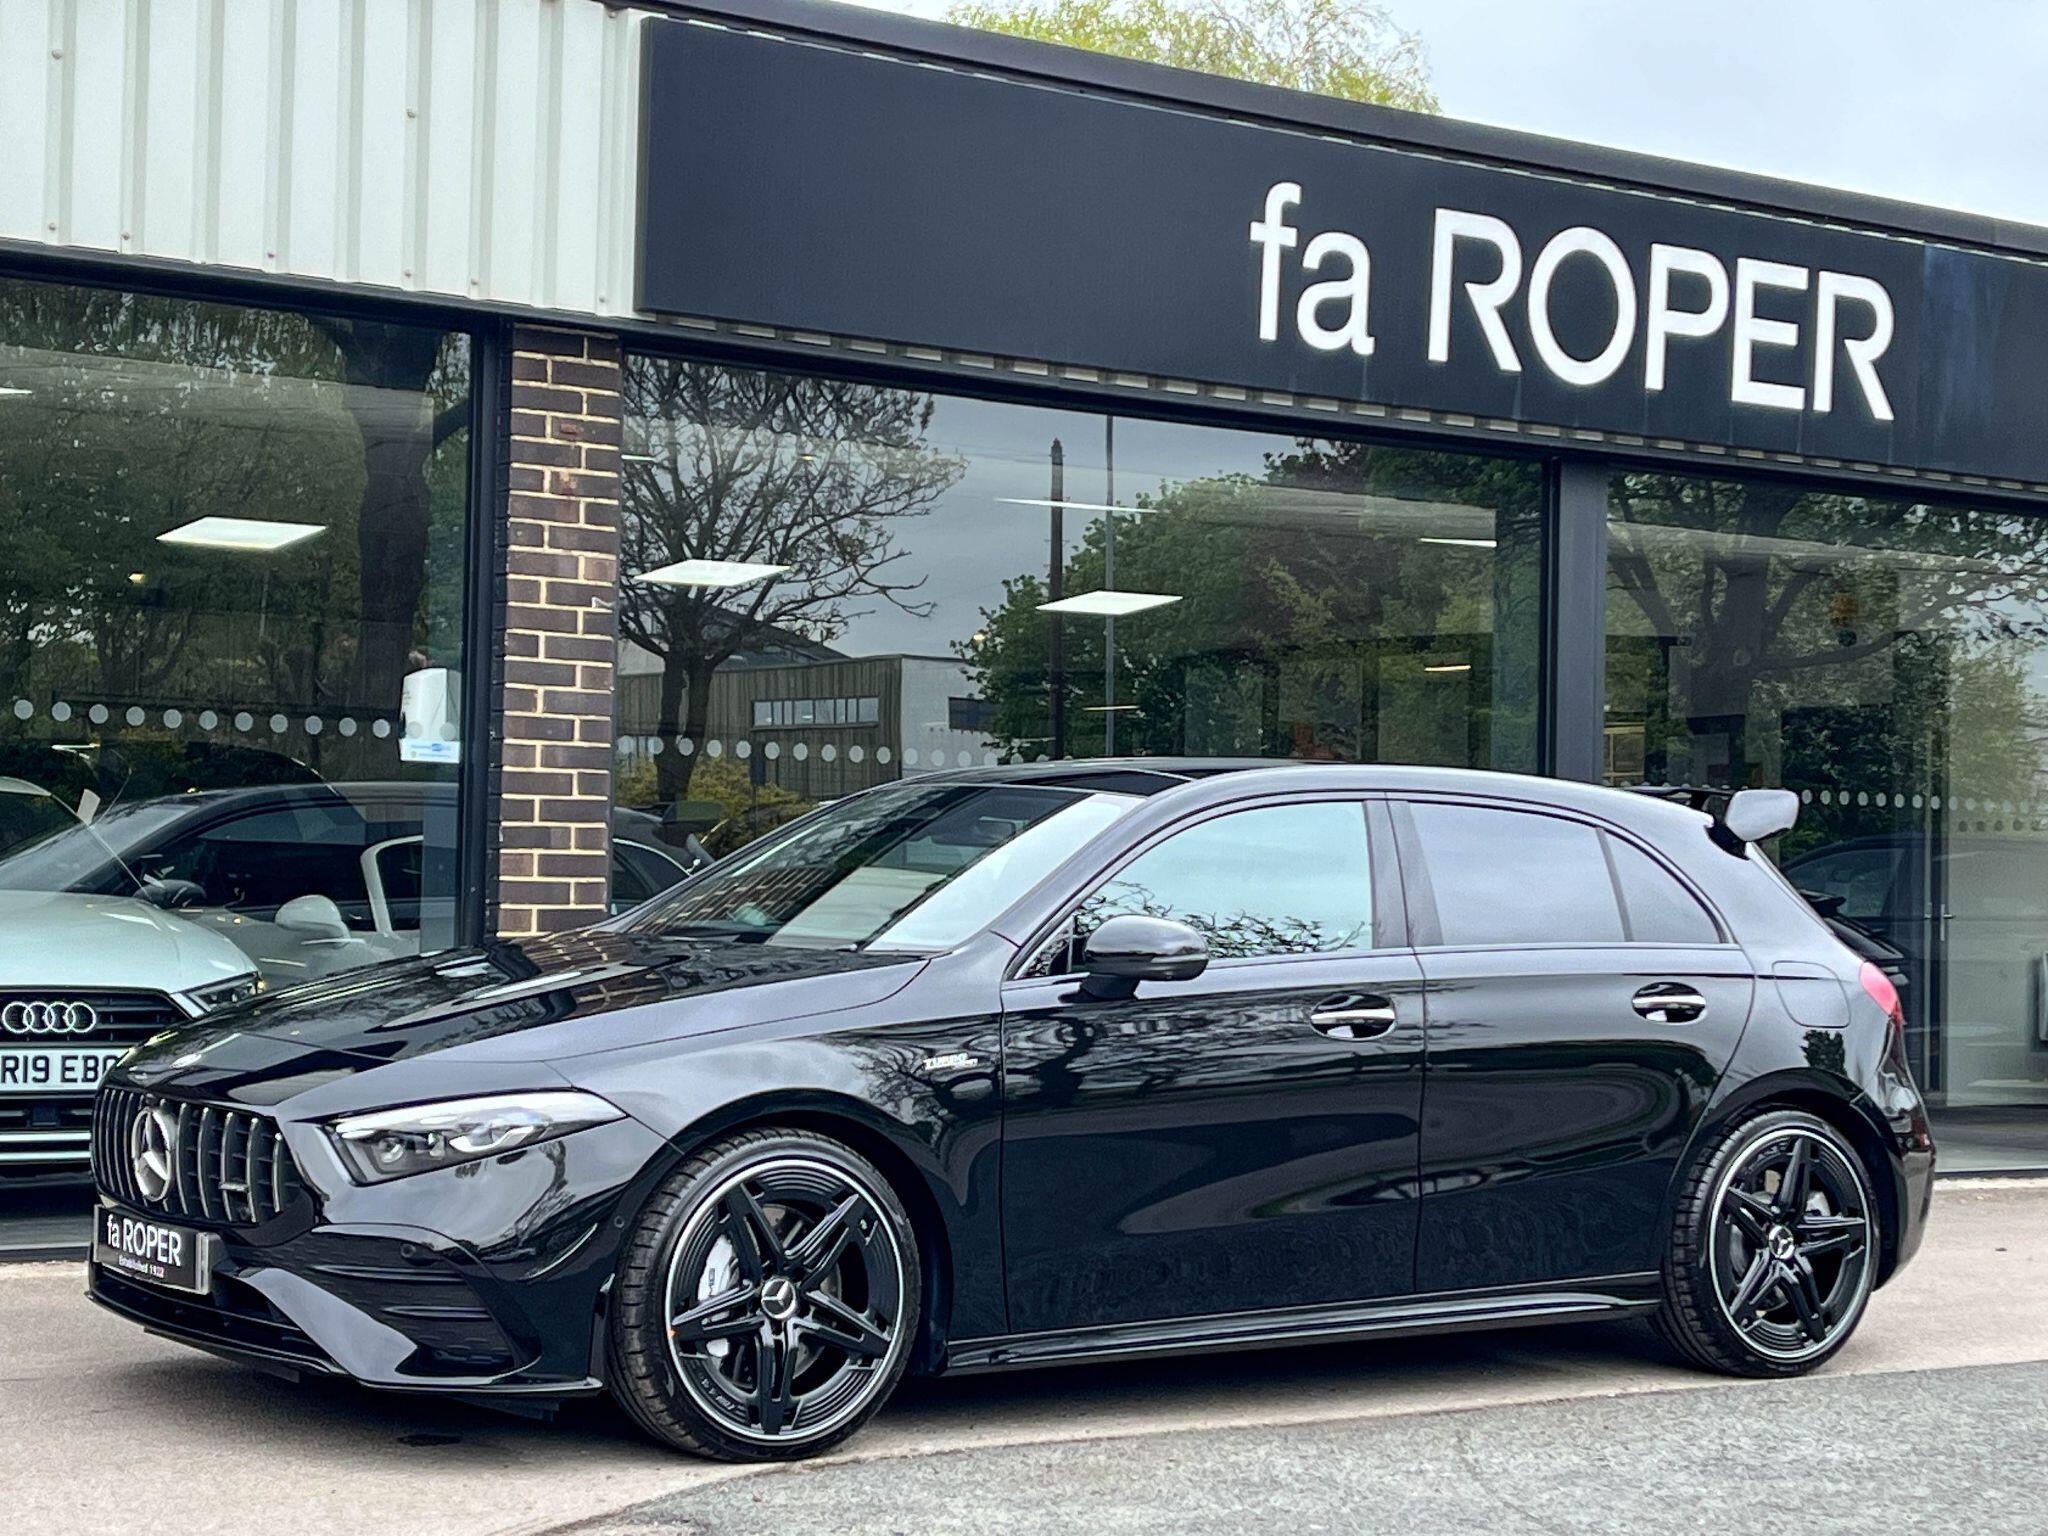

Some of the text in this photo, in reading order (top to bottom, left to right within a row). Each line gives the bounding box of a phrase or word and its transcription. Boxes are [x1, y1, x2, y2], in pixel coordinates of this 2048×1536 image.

[1249, 182, 1894, 421] fa ROPER
[0, 1055, 50, 1083] R19
[107, 1213, 182, 1267] fa ROPER
